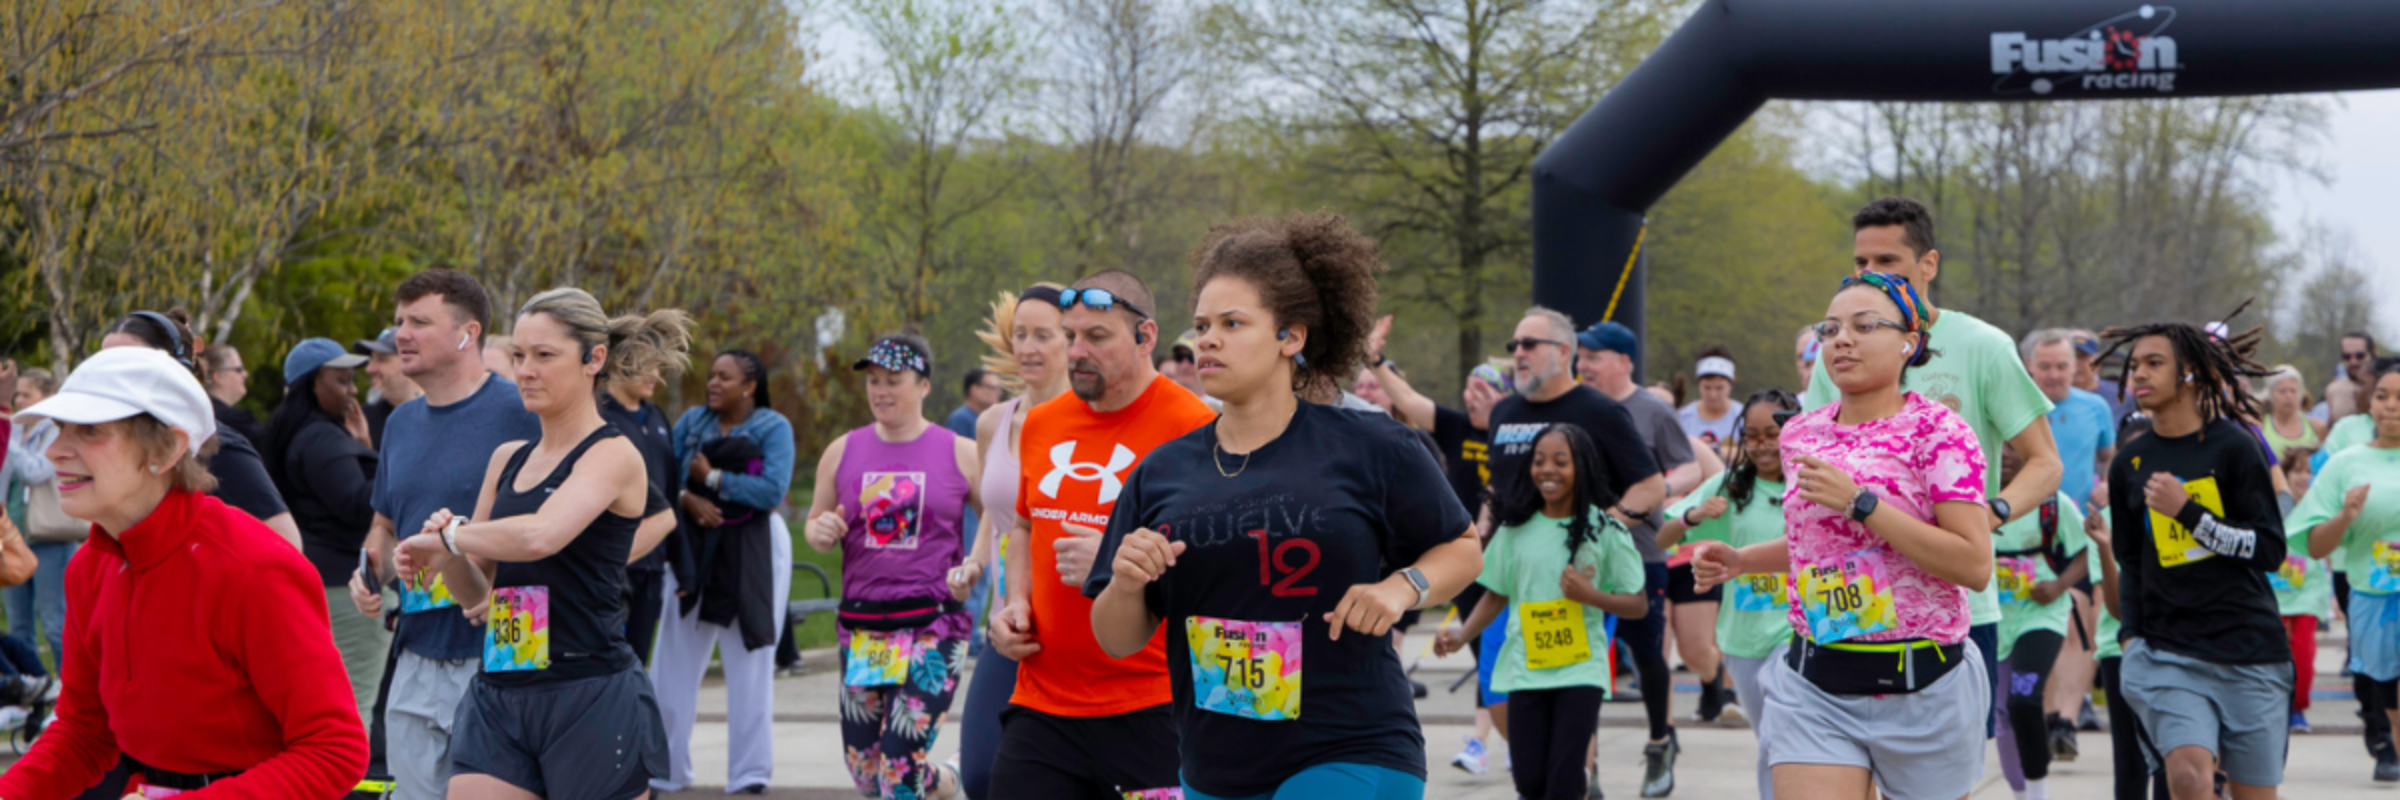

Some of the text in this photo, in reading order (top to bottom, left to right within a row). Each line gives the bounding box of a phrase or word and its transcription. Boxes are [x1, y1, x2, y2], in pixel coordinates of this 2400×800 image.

[1990, 29, 2178, 74] Fusion
[2082, 72, 2176, 92] racing
[1068, 511, 1110, 526] ARMO
[1247, 528, 1322, 597] 12
[1812, 561, 1856, 578] Fusin
[1816, 583, 1862, 617] 708
[494, 617, 520, 644] 836
[1215, 625, 1267, 642] Fusin
[1534, 627, 1574, 650] 5248
[1216, 653, 1265, 689] 715
